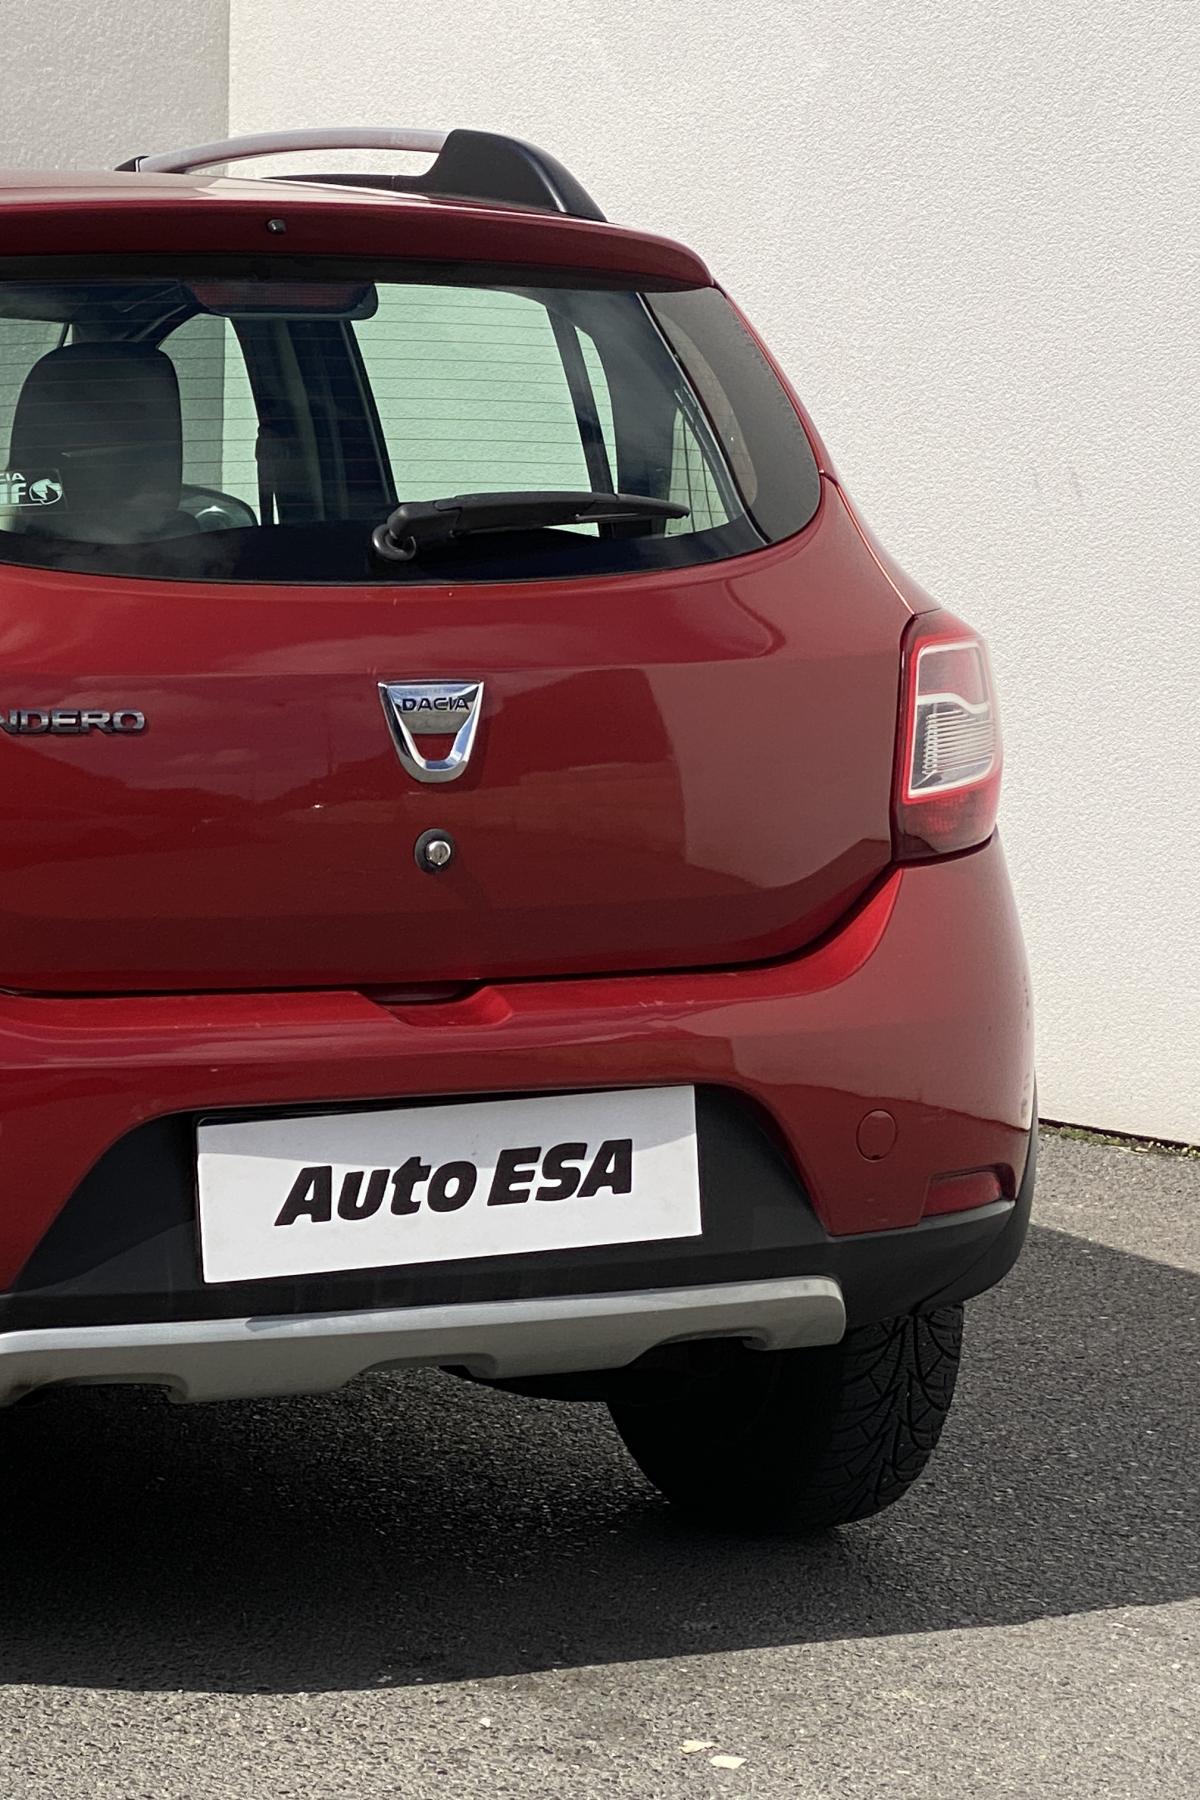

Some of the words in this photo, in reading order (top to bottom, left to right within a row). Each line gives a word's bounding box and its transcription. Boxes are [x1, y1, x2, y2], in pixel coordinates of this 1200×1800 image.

[402, 696, 470, 712] DACIA
[273, 1155, 478, 1228] Auto
[486, 1137, 634, 1208] ESA
